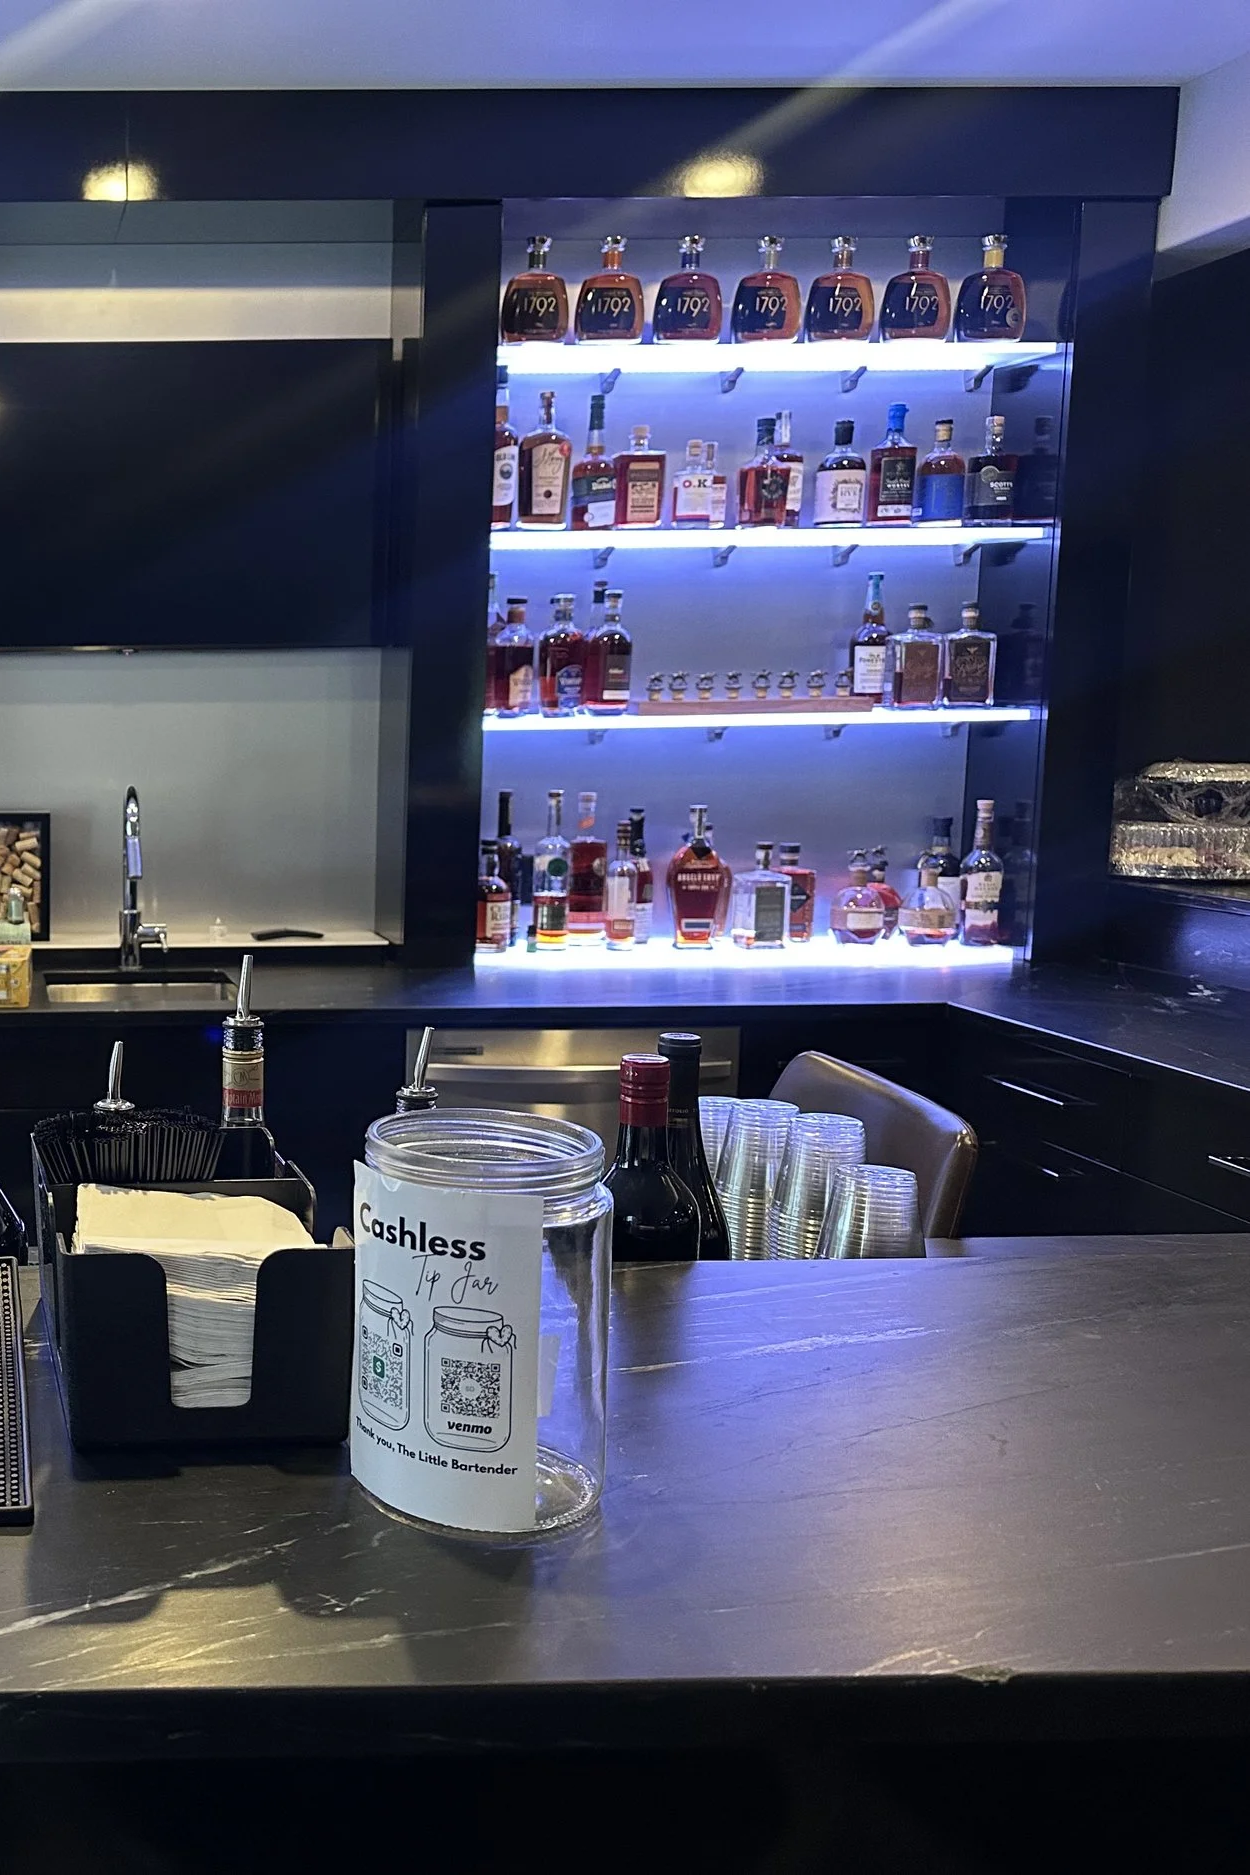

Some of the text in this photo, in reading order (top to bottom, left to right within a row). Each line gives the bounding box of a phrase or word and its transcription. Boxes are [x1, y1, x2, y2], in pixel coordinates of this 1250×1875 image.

[524, 297, 556, 317] 1792
[598, 297, 631, 317] 1792
[677, 297, 710, 317] 1792
[755, 297, 788, 317] 1792
[829, 297, 862, 317] 1792
[905, 296, 939, 316] 1792
[981, 295, 1014, 316] 1792
[360, 1202, 486, 1261] Cashless
[412, 1253, 499, 1304] Tip Jar
[447, 1420, 493, 1435] venmo
[355, 1416, 518, 1476] Thank you, The Little Bartender
